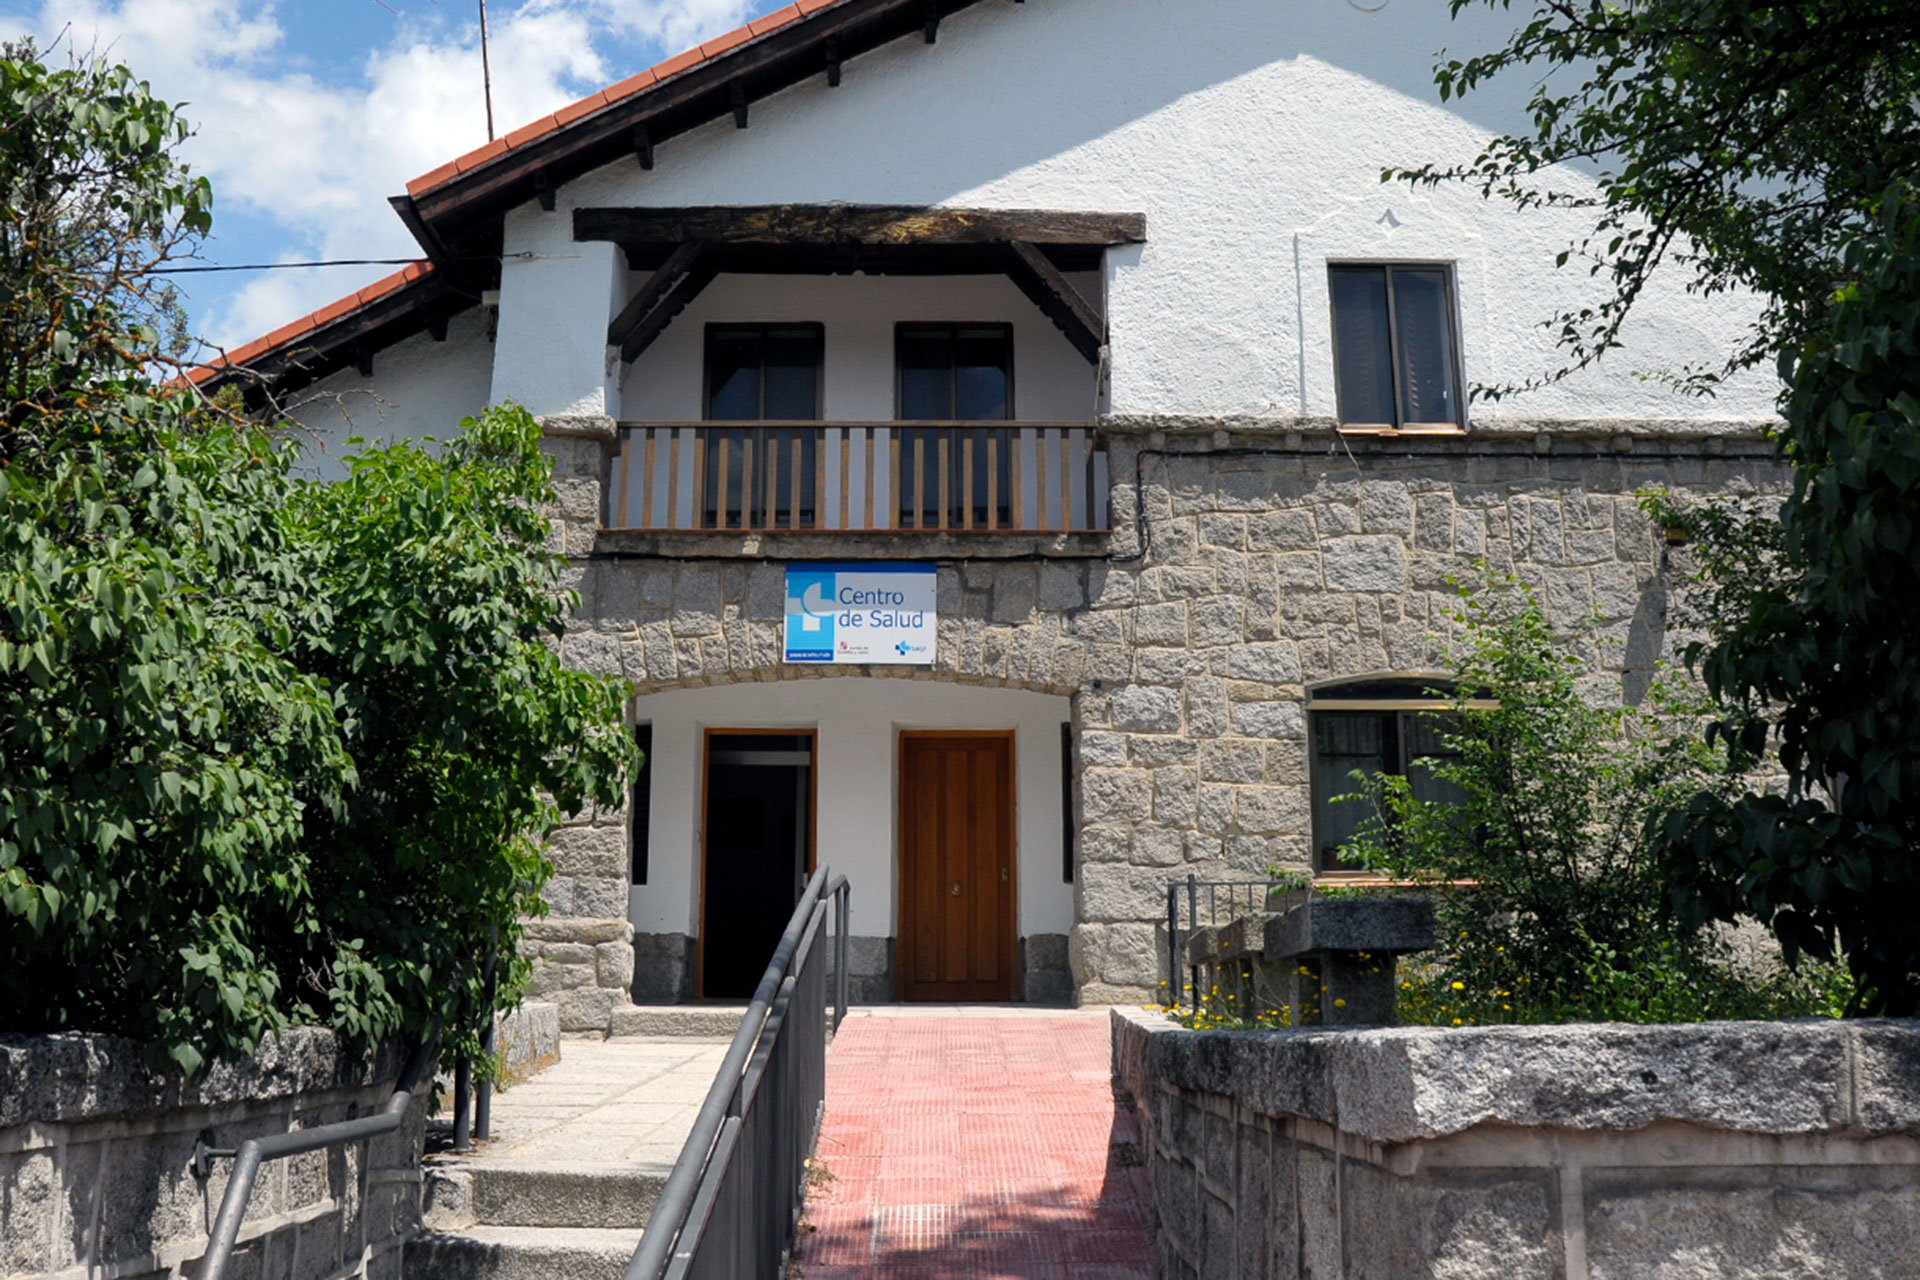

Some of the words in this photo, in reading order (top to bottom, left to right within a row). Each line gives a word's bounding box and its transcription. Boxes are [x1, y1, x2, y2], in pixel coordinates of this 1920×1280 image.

[839, 587, 904, 605] Centro
[839, 609, 863, 628] de
[870, 610, 923, 628] Salud
